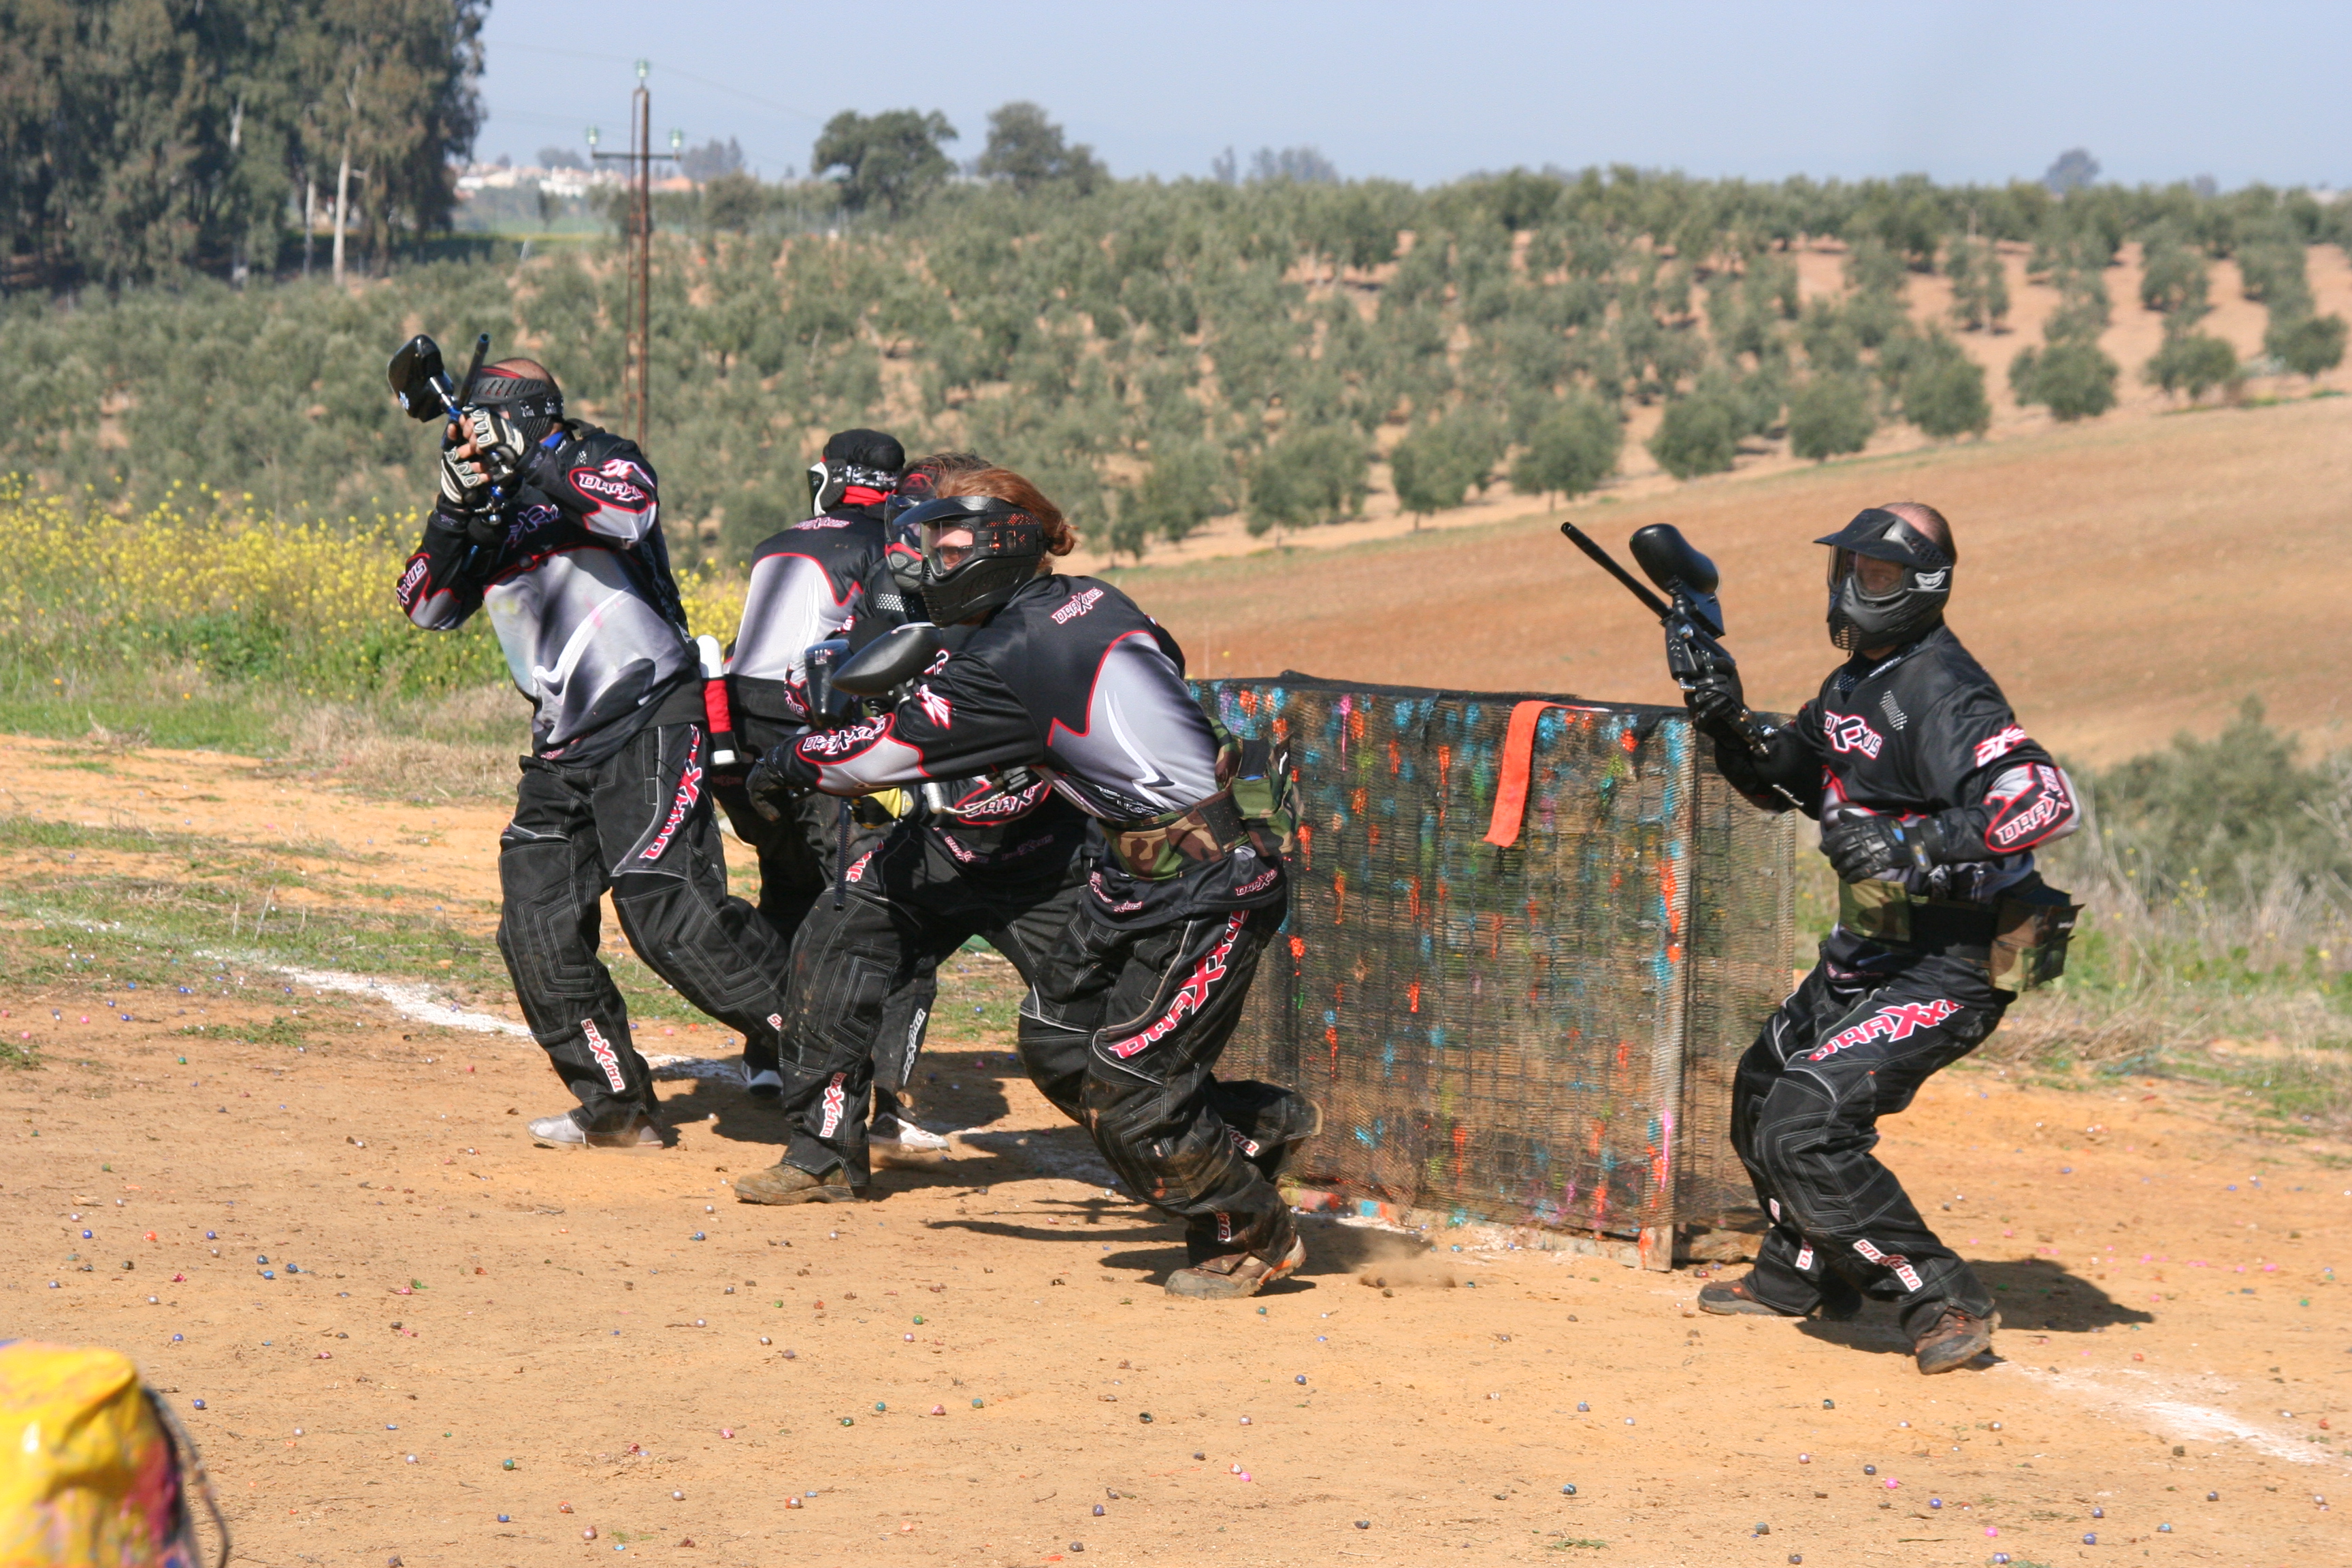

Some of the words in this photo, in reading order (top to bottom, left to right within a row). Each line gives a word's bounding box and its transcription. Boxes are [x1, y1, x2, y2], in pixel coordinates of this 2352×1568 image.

[1050, 587, 1104, 625] DRAXXUS
[581, 1018, 625, 1092] DRAXXUS
[1807, 998, 1964, 1062] DRAXX
[819, 1072, 848, 1139] DRAXXUS
